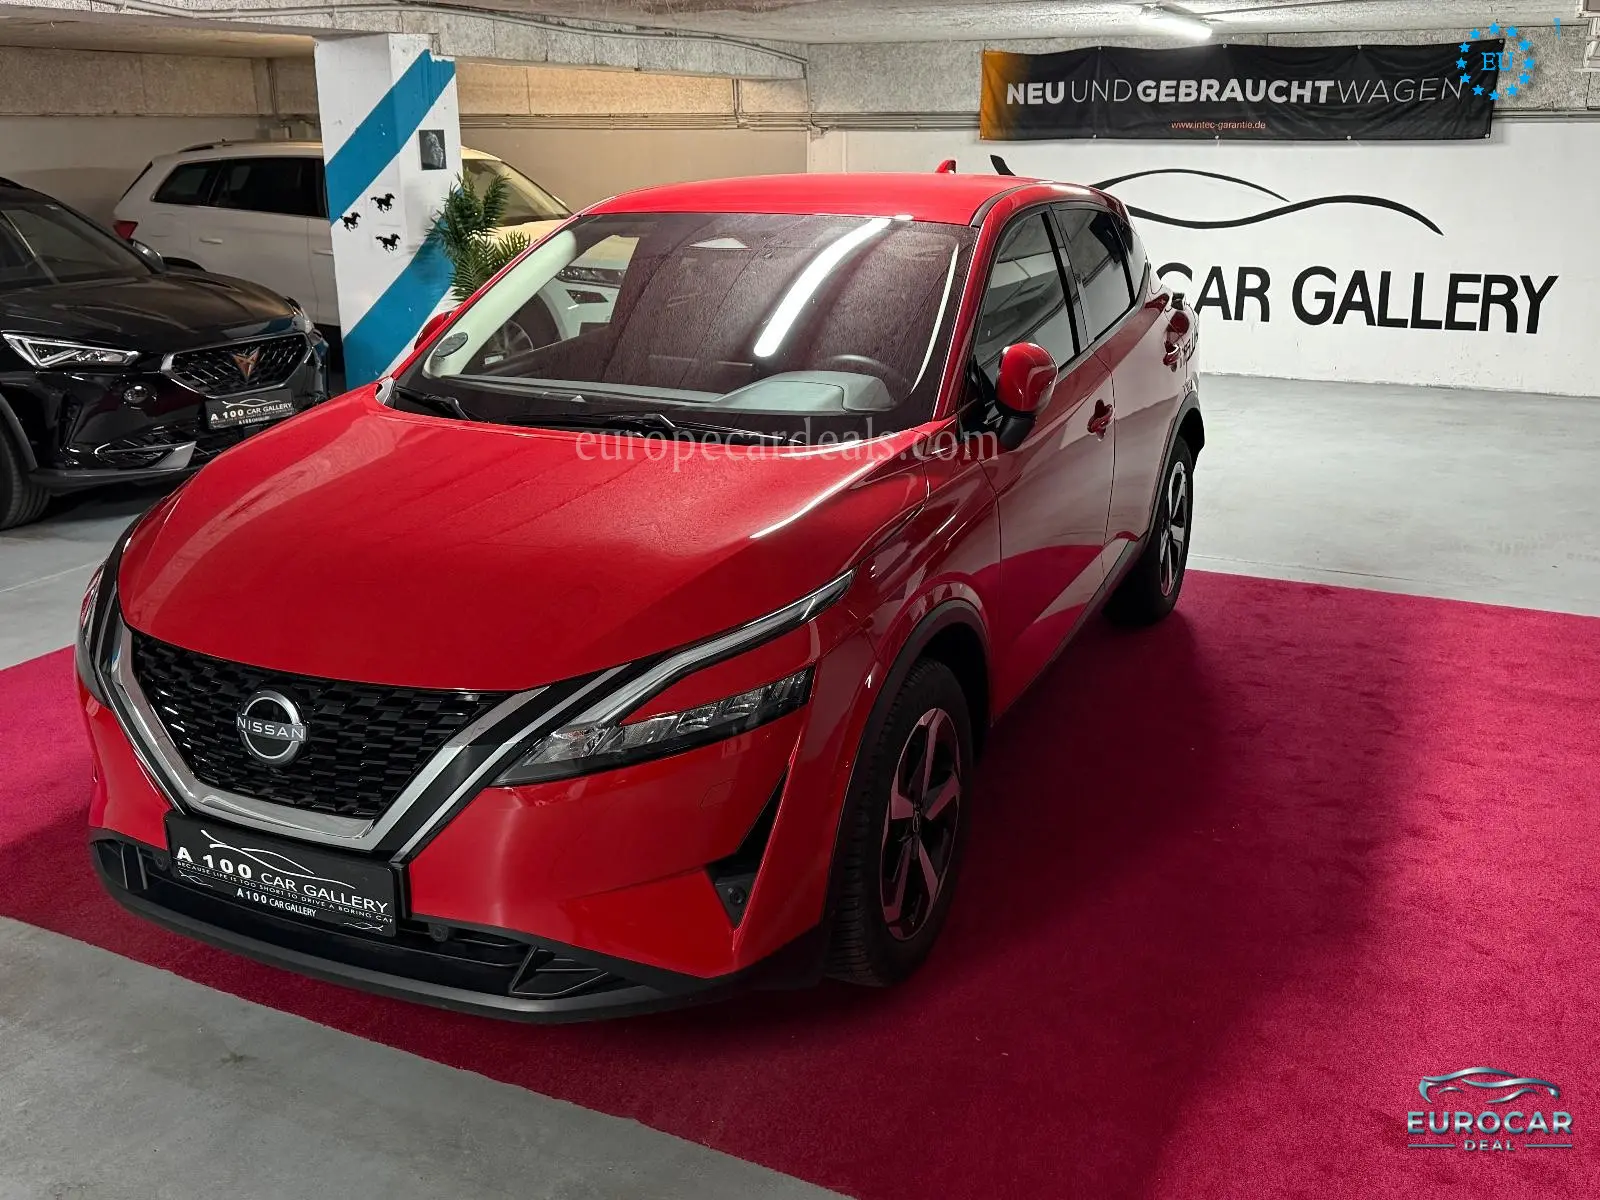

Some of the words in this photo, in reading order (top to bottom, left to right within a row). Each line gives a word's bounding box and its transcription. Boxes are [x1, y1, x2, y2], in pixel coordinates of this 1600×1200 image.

[1006, 81, 1065, 105] NEU
[1070, 79, 1132, 102] UND
[1170, 120, 1266, 131] www.intec-garantie.de
[1292, 265, 1559, 334] GALLERY
[210, 413, 219, 421] A
[246, 407, 261, 415] CAR
[263, 402, 292, 412] GALLERY
[237, 716, 304, 740] NISSAN
[177, 846, 193, 863] A
[202, 854, 252, 879] 100
[261, 873, 298, 892] CAR
[303, 884, 388, 914] GALLERY
